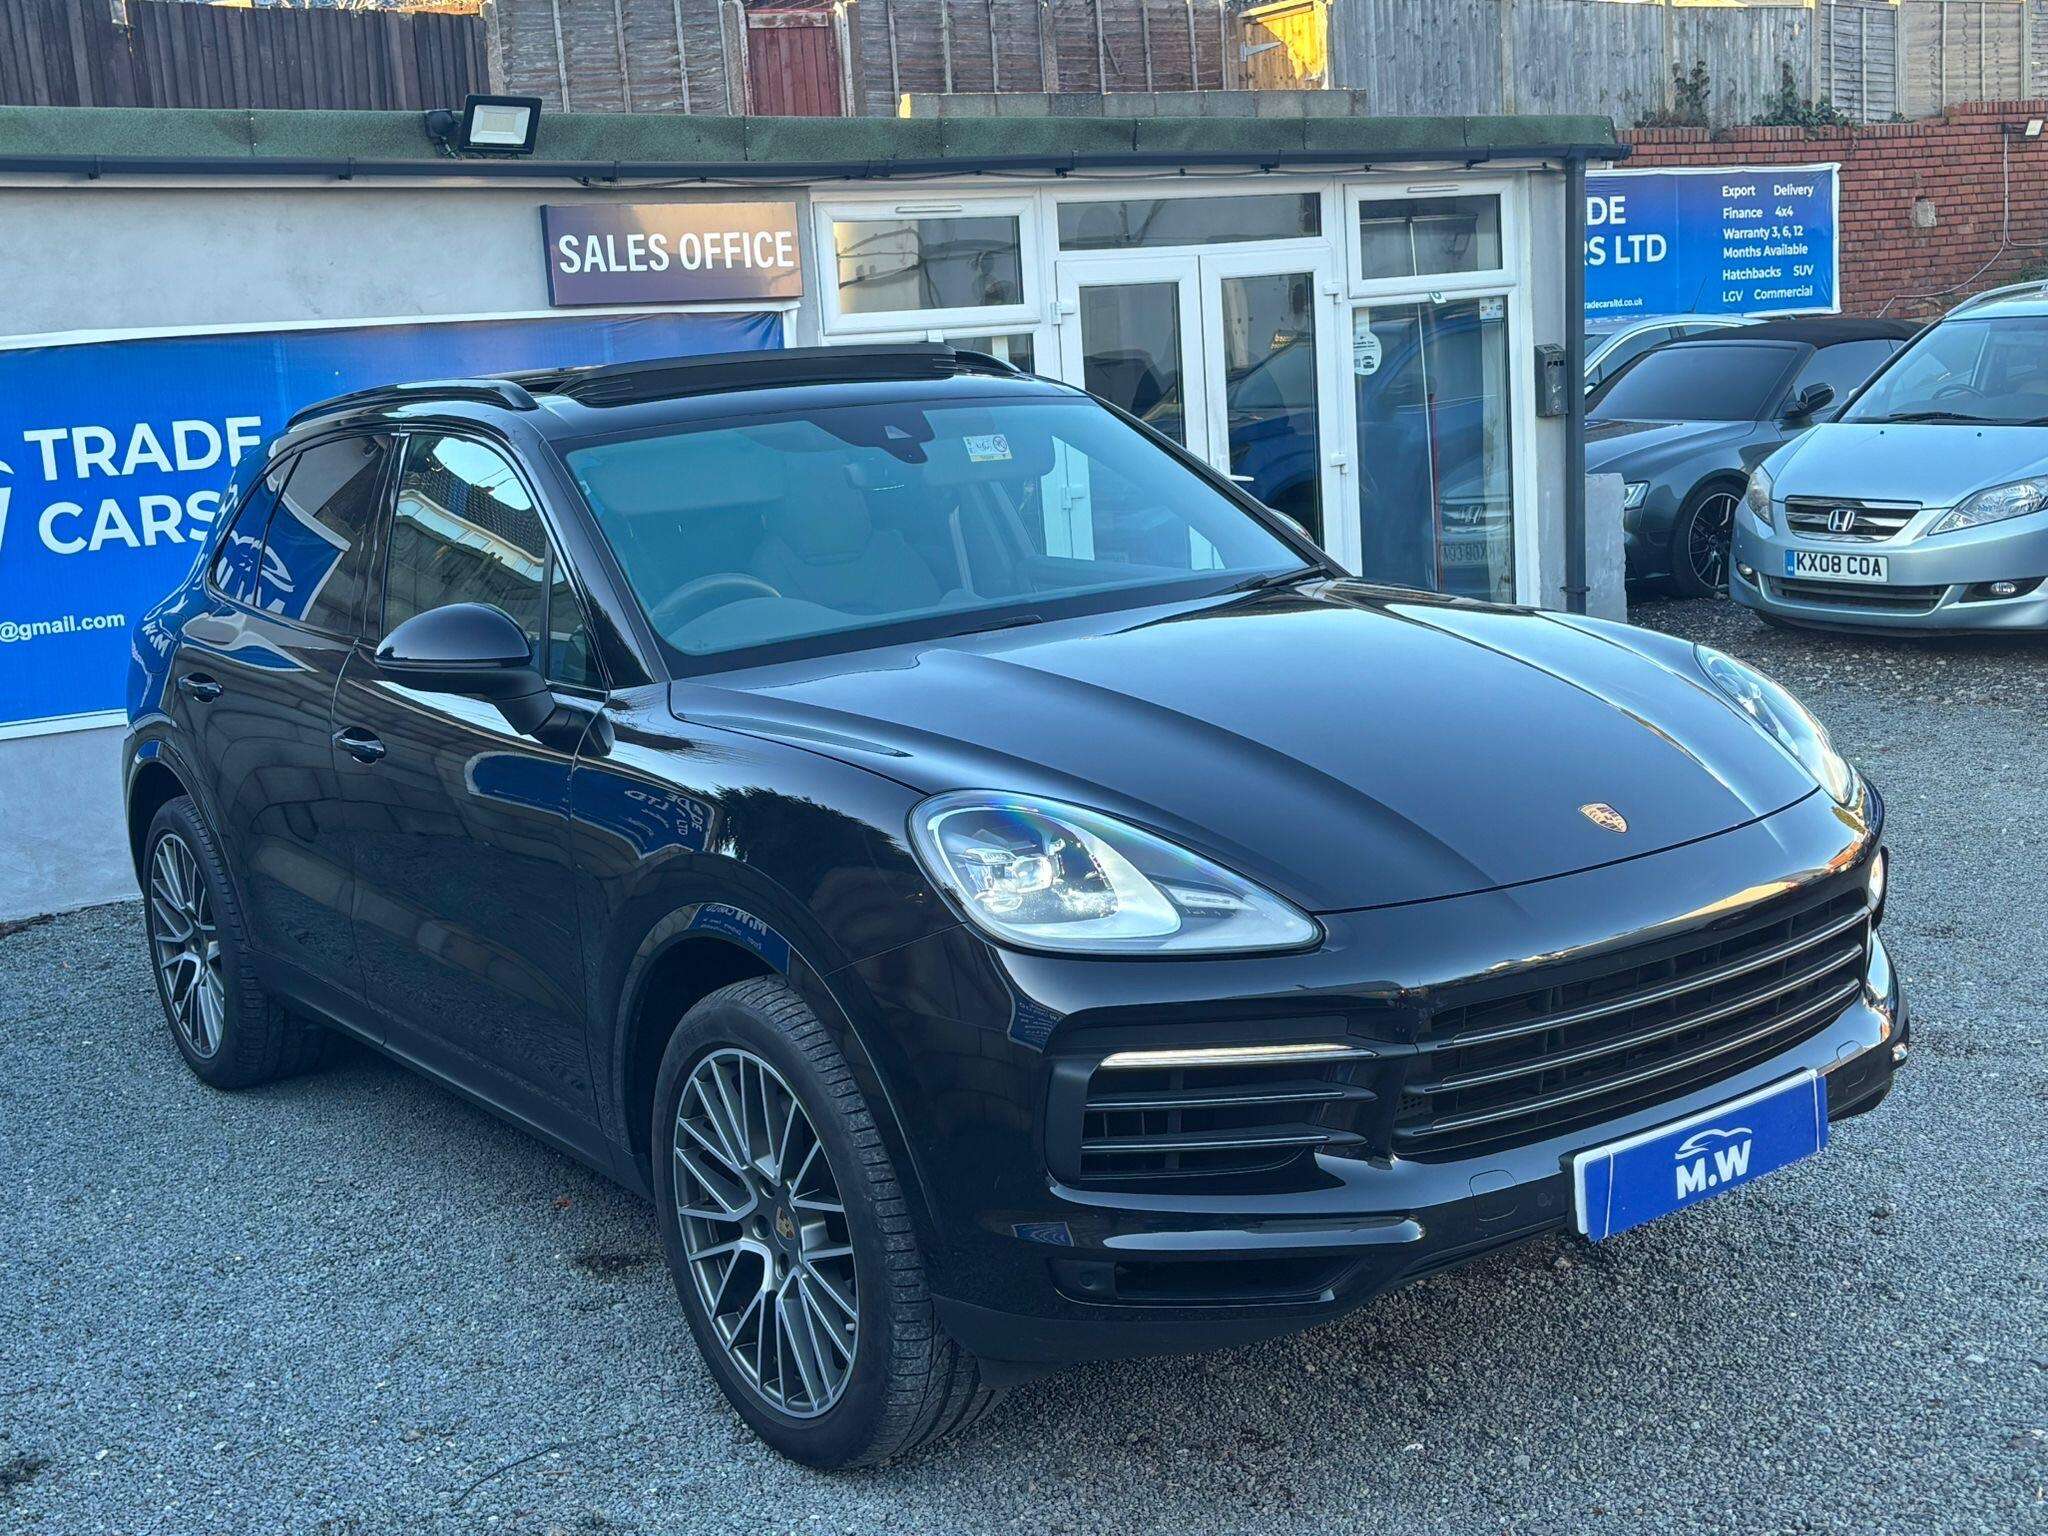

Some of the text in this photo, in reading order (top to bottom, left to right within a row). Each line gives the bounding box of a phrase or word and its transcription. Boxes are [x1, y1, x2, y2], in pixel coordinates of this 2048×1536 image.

[1722, 183, 1814, 199] Export Delivery
[1585, 196, 1626, 226] DE
[1723, 205, 1794, 219] Finance 4x4
[1723, 225, 1804, 240] Warranty 3, 6, 12
[558, 230, 794, 274] SALES OFFICE
[1584, 233, 1667, 266] S LTD
[1723, 243, 1809, 259] Months Available
[1722, 264, 1814, 281] Hatchbacks SUV
[1722, 285, 1813, 302] LGV Commercial
[23, 415, 262, 481] TRADE
[38, 490, 221, 555] CARS
[1796, 552, 1882, 577] KX08 COA
[0, 613, 126, 642] @gmail.com
[1676, 1139, 1752, 1200] M.W
